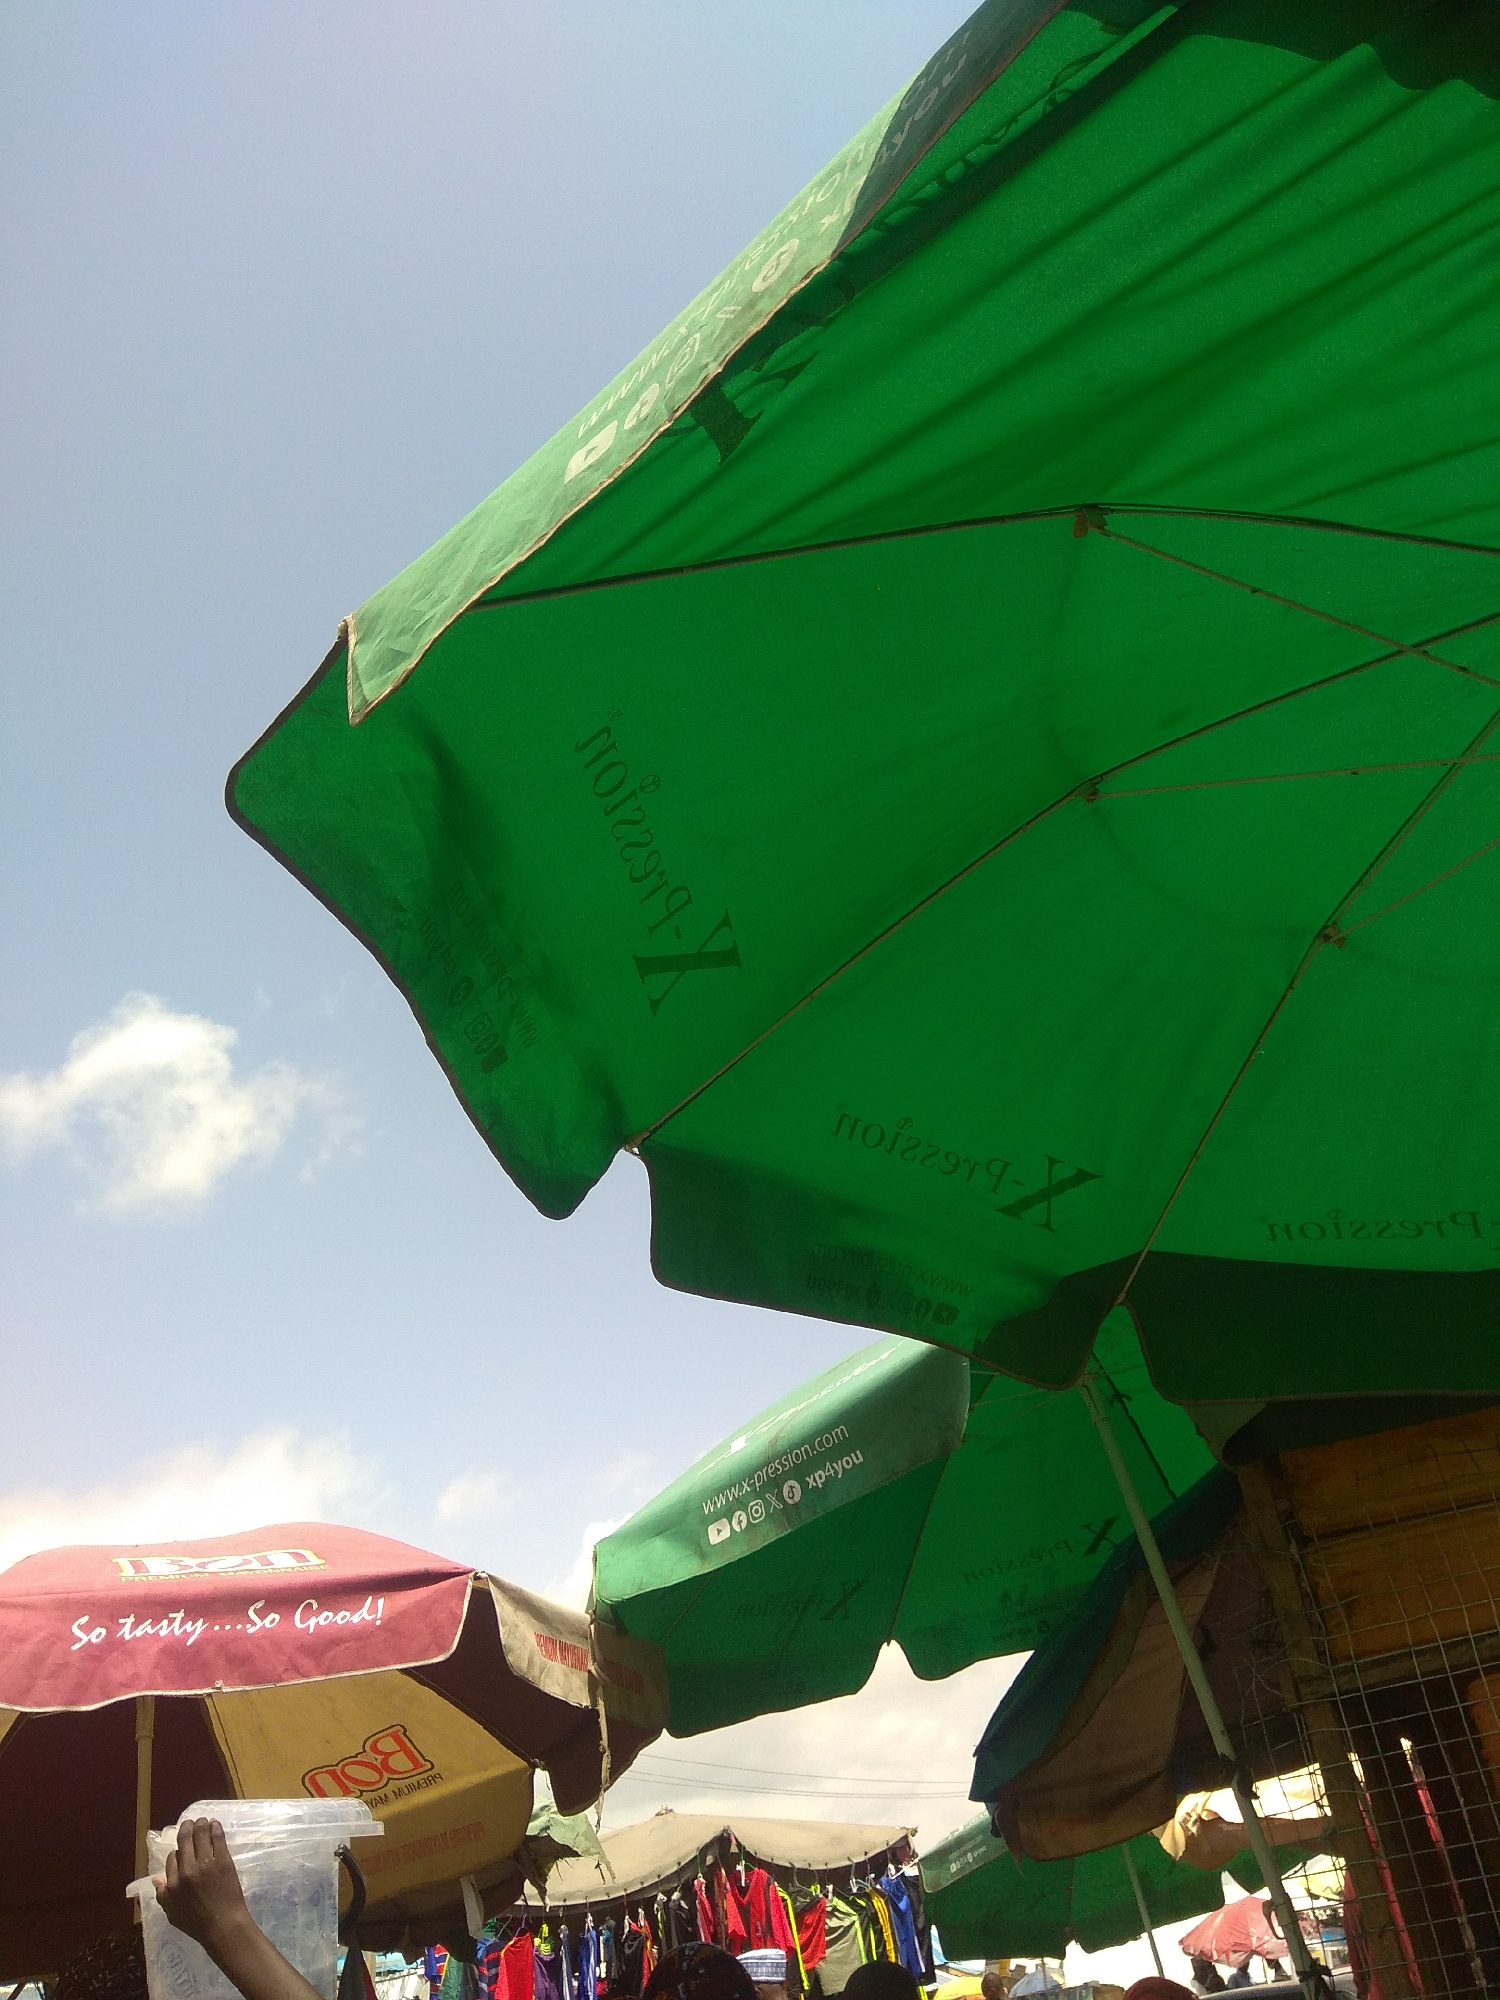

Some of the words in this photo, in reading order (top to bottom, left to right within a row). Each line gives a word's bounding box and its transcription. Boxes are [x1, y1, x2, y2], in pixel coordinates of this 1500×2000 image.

[702, 1424, 849, 1515] www.x-pression.com
[805, 1449, 864, 1490] xp4you
[70, 1614, 107, 1651] So
[293, 1595, 386, 1634] Good!
